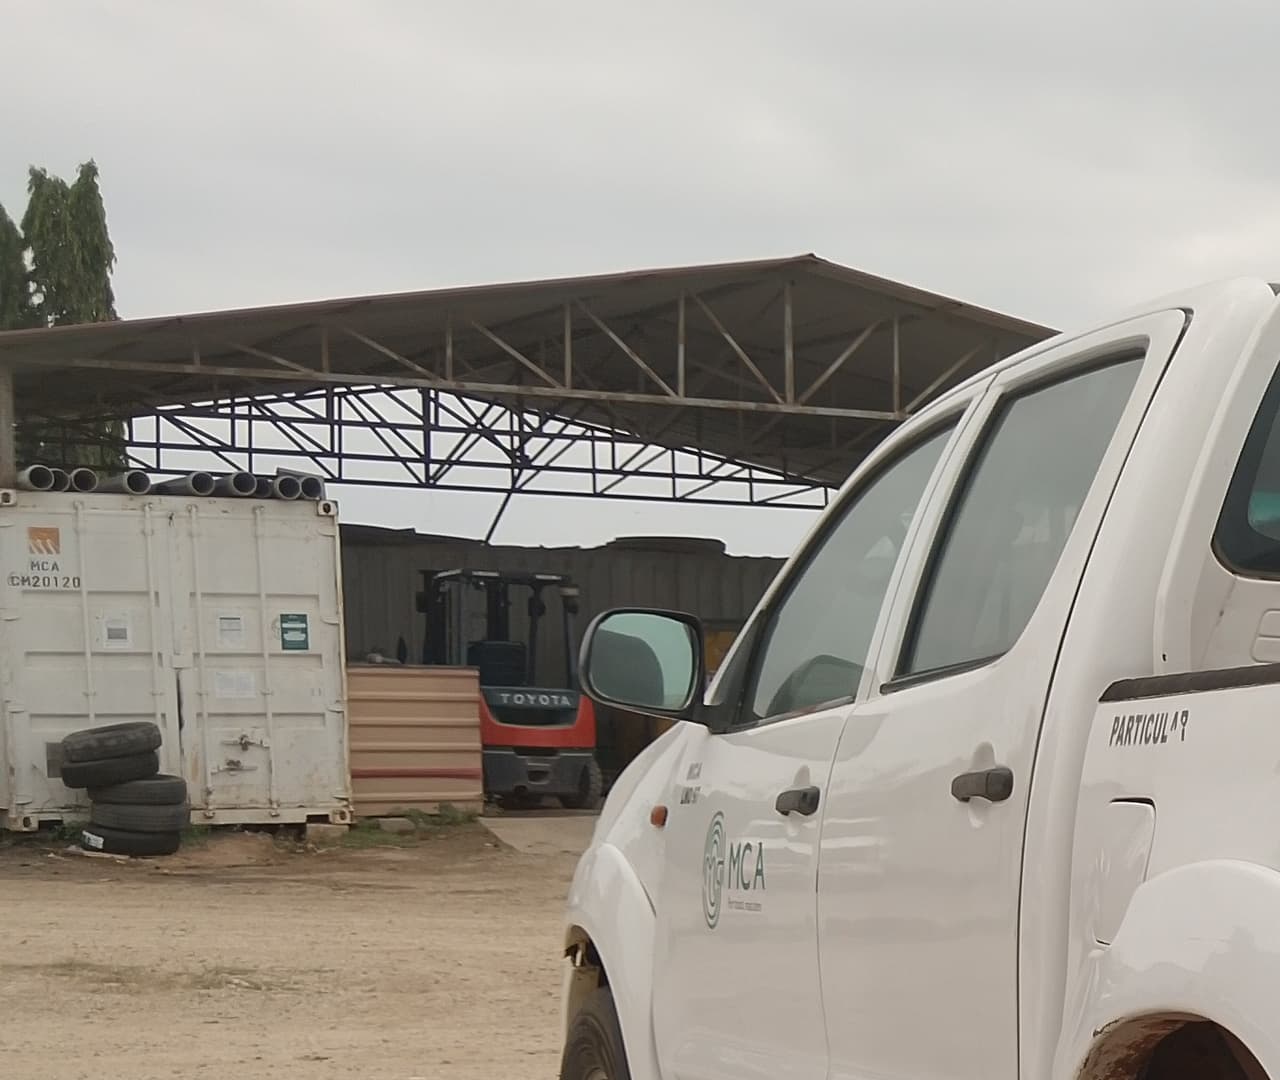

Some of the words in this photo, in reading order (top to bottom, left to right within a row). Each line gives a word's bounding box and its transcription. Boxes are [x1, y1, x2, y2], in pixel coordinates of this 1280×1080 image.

[30, 560, 60, 572] MCA
[500, 693, 571, 706] TOYOTA
[727, 841, 766, 890] MCA
